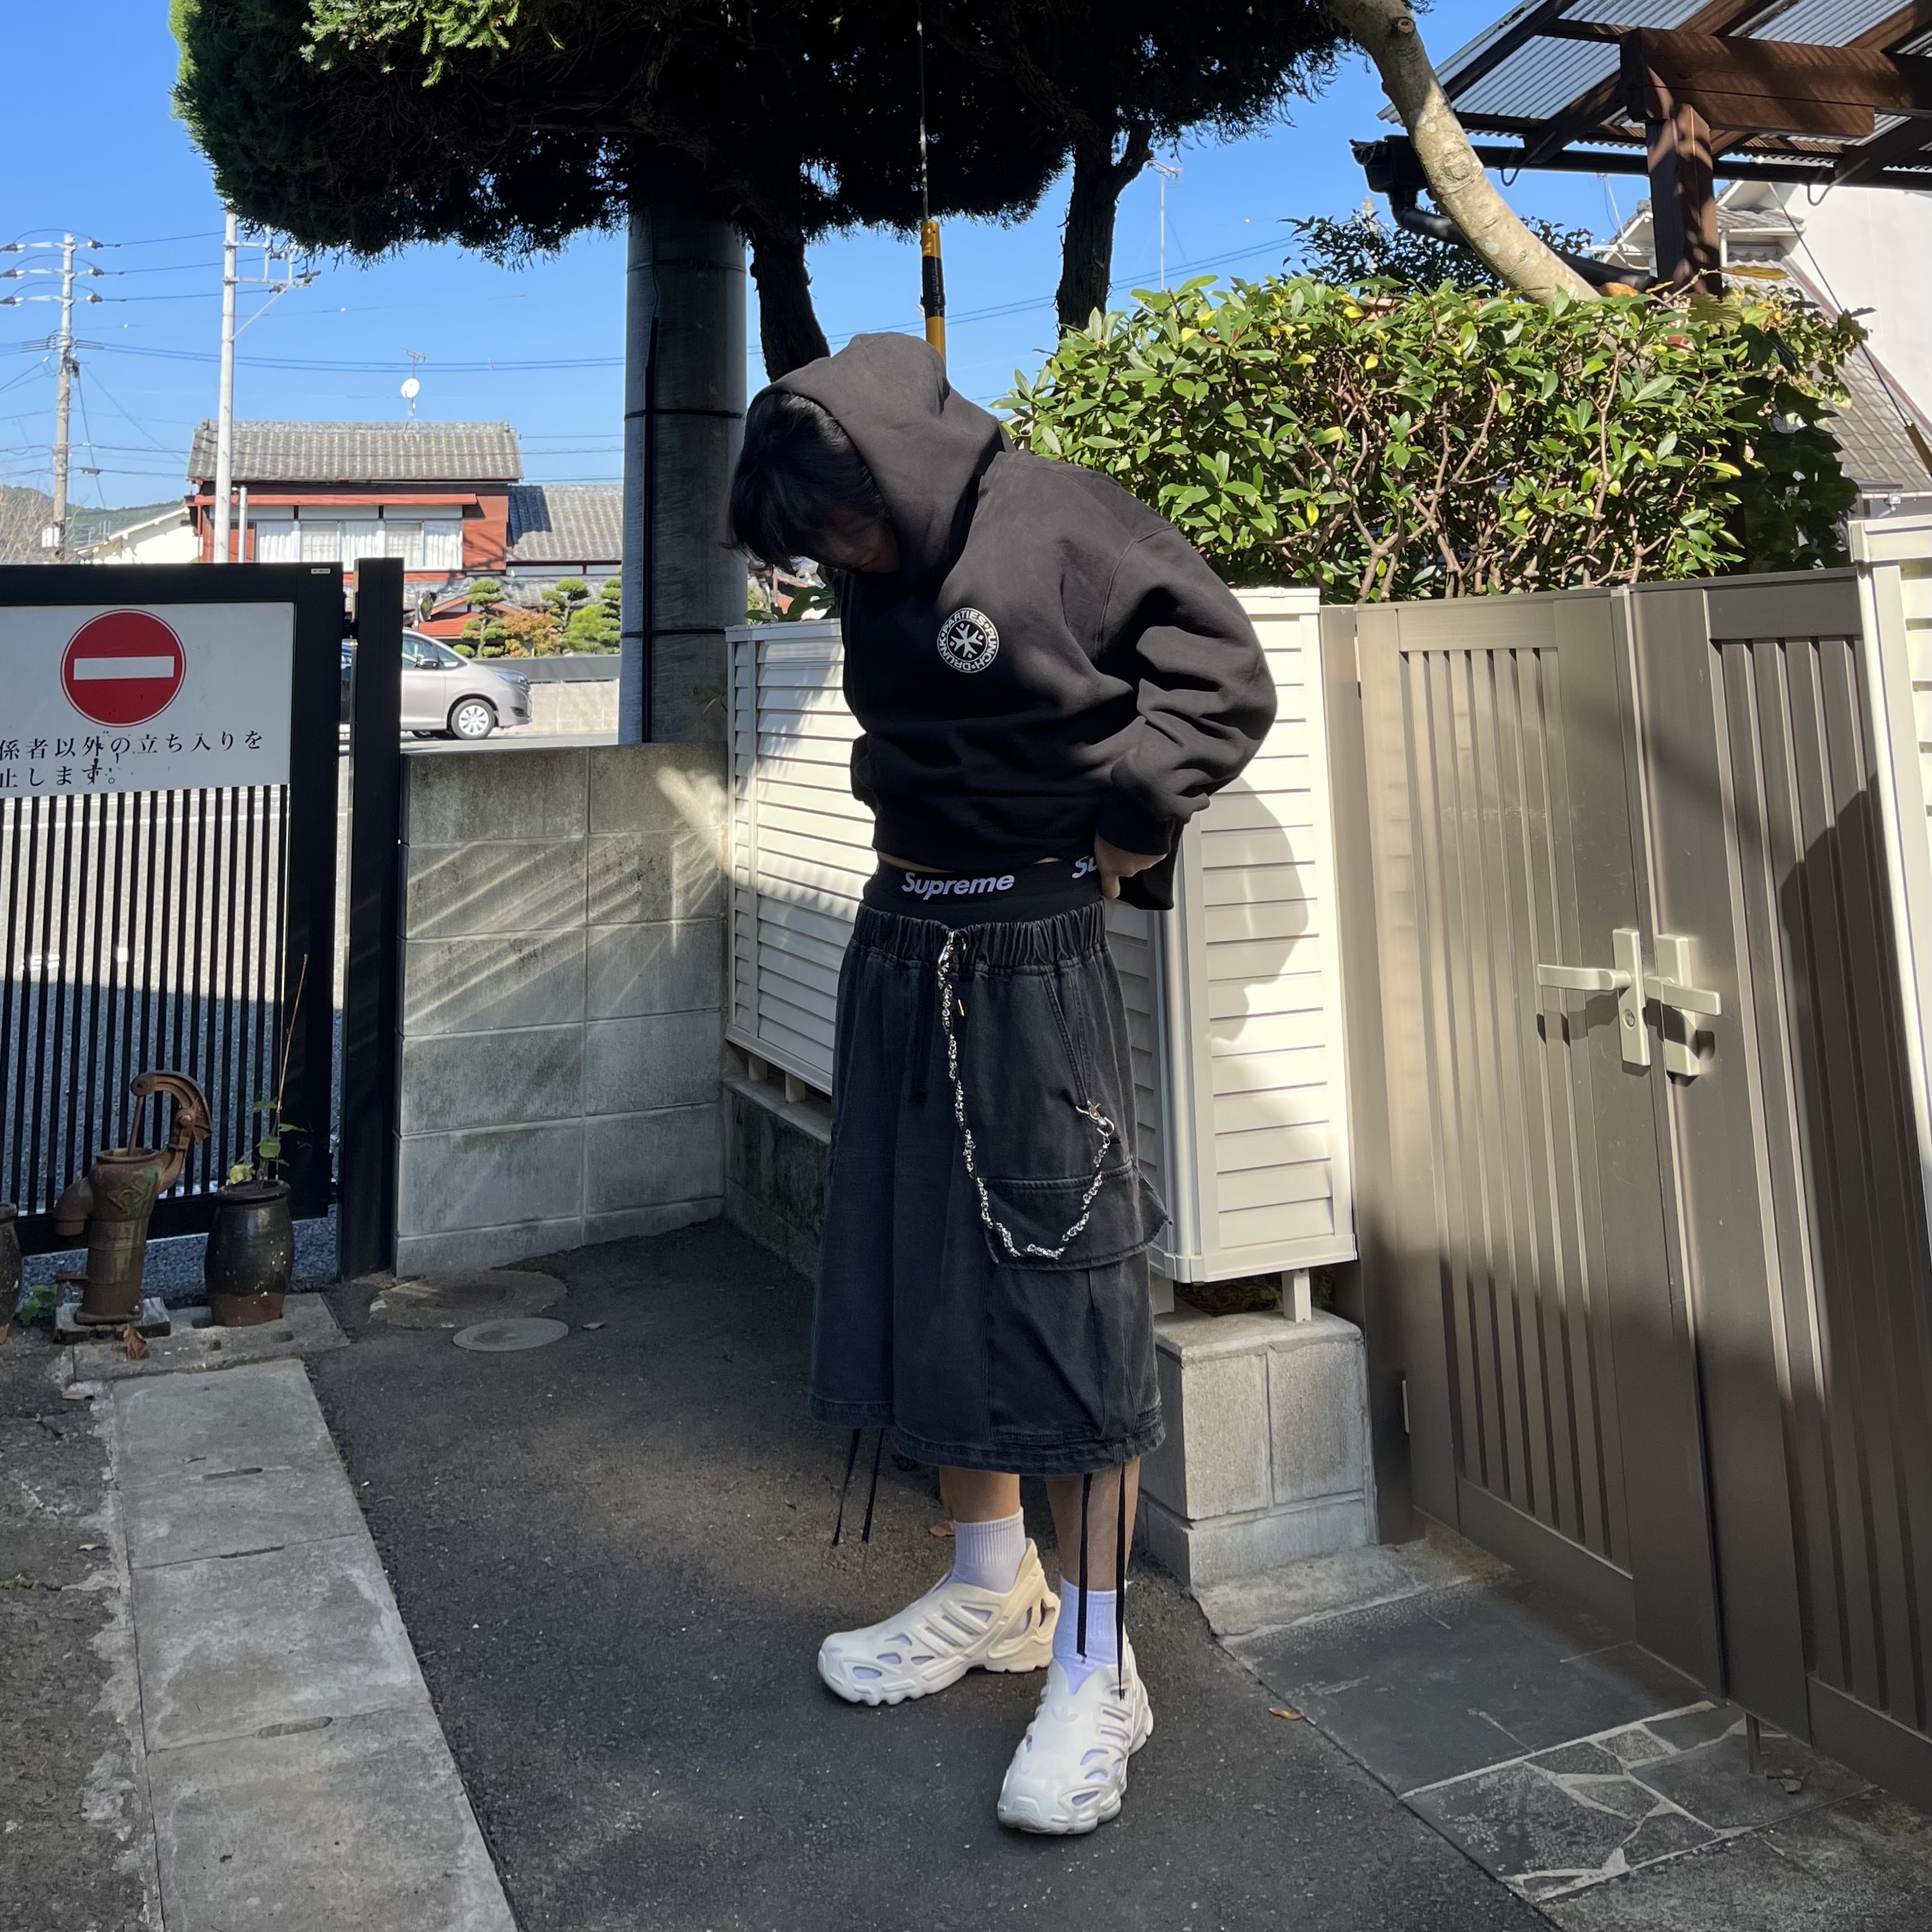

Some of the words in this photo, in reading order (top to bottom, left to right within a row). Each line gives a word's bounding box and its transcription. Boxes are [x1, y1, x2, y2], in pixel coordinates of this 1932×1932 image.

[942, 610, 987, 633] PARTIES
[939, 636, 971, 670] DRUNK
[974, 627, 997, 669] PUNCH
[0, 731, 263, 760] 係者以外の立ち入りを
[0, 764, 115, 788] 止します。
[902, 871, 1015, 900] Supreme
